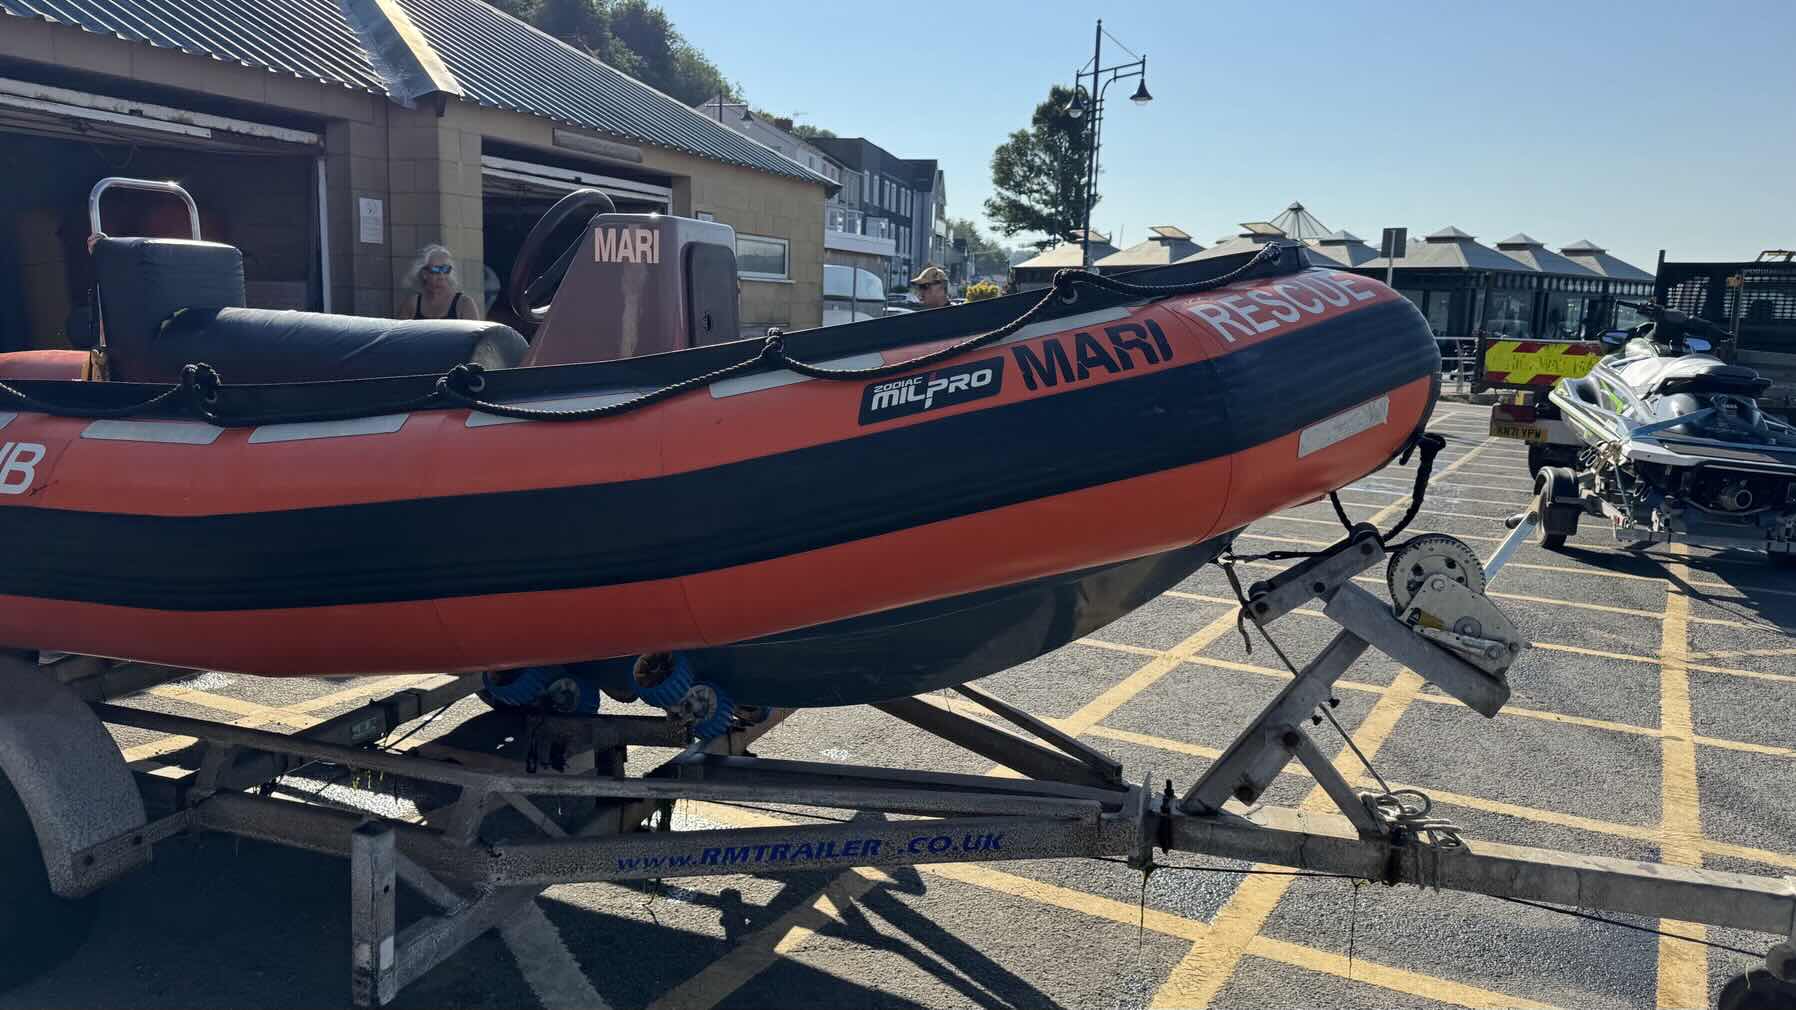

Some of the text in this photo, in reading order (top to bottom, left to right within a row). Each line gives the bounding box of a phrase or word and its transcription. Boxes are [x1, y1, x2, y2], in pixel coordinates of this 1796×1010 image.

[594, 227, 660, 264] MARI
[1011, 271, 1376, 391] MARI RESCUE
[873, 376, 923, 393] ZODIAC
